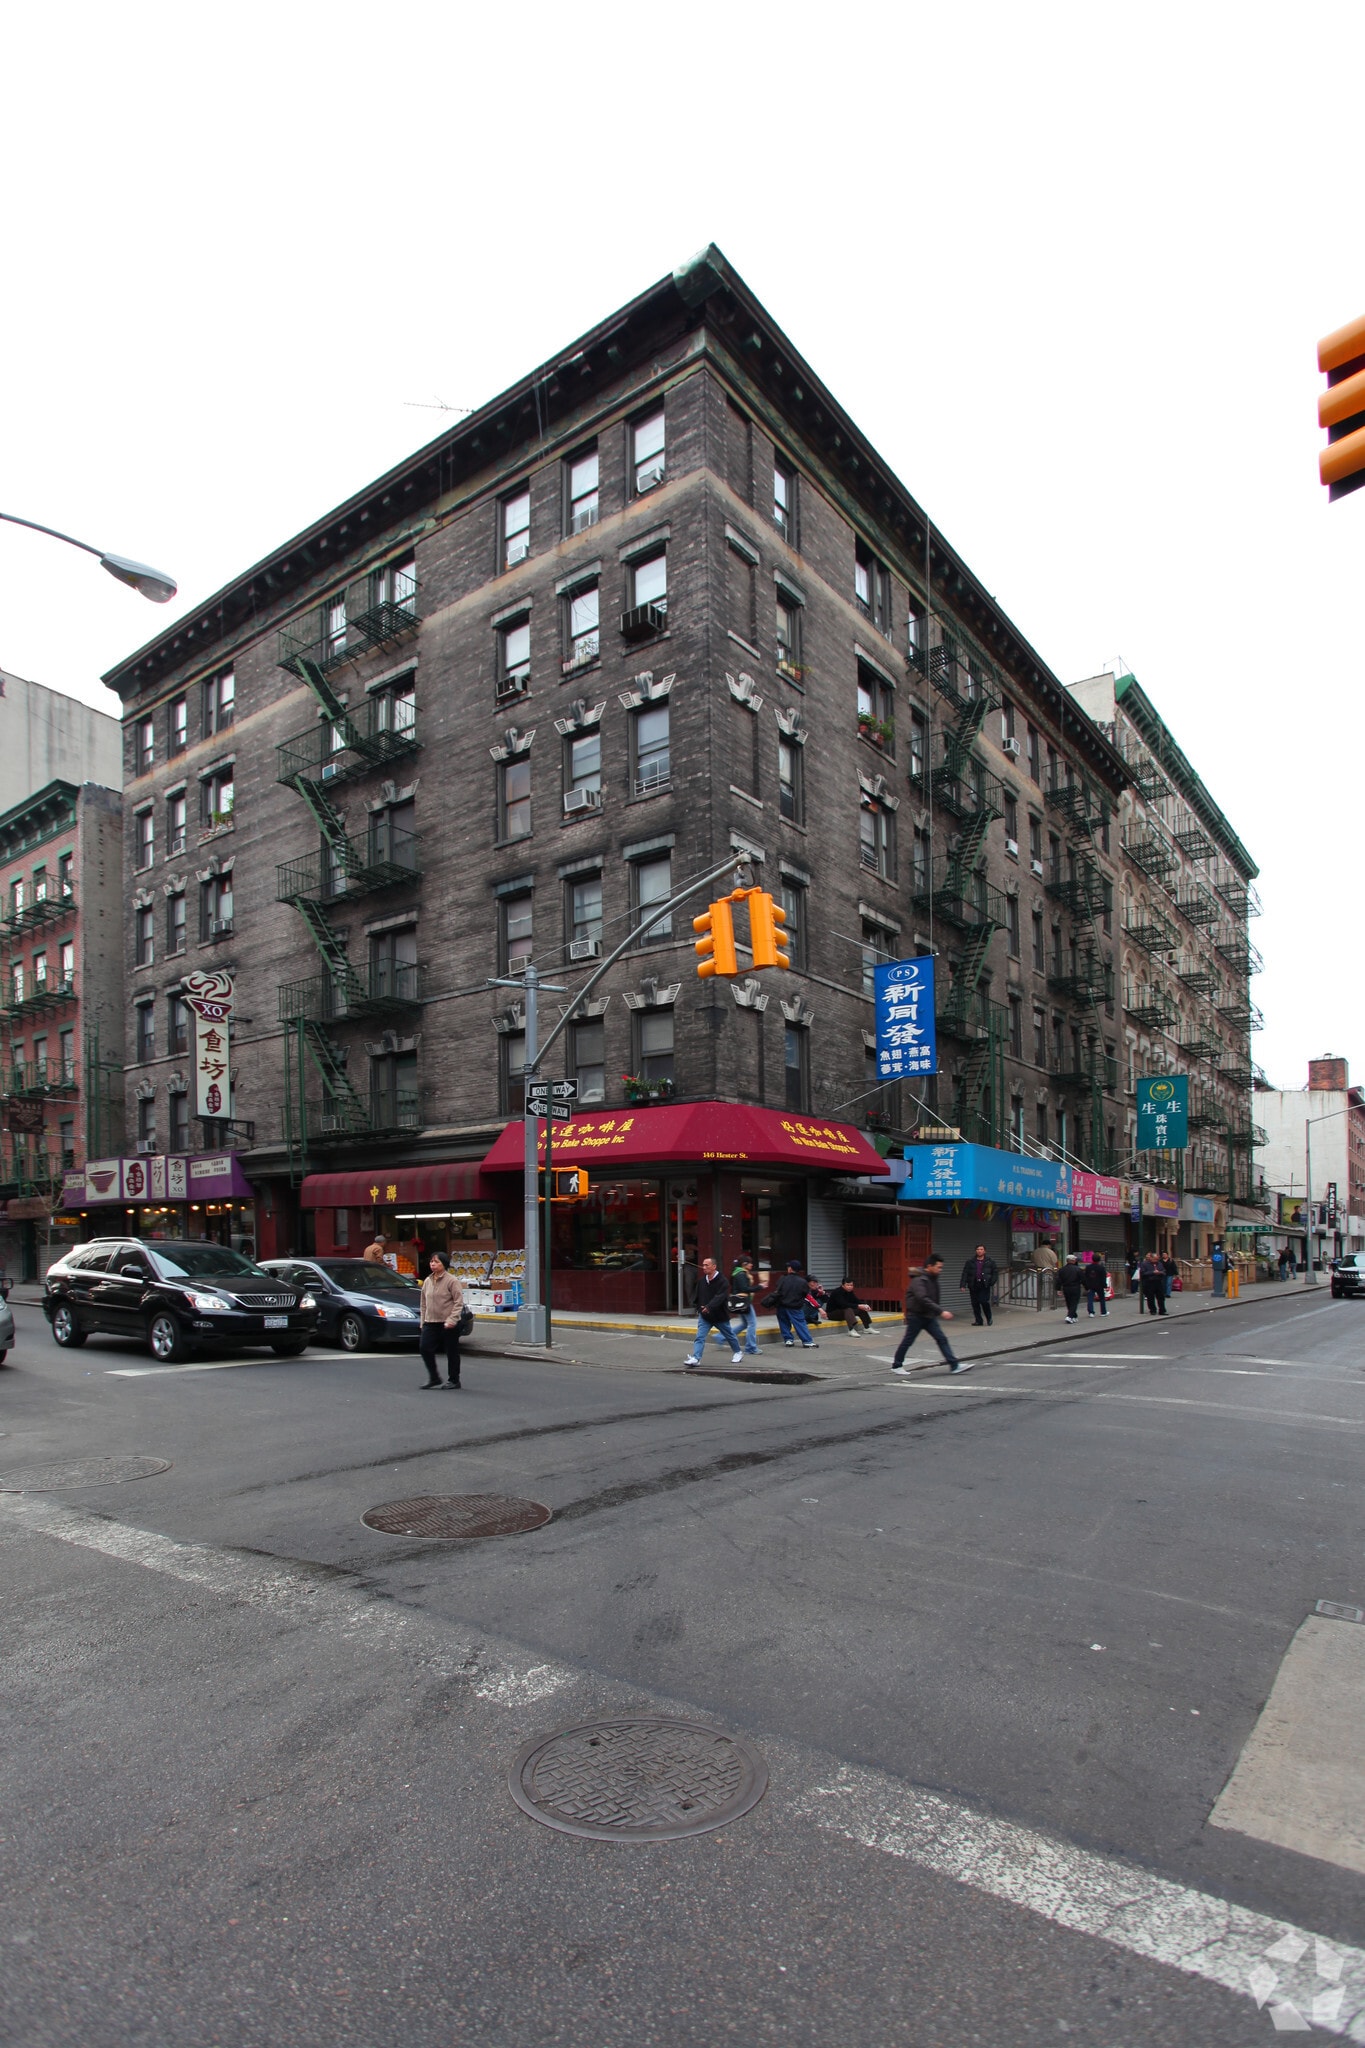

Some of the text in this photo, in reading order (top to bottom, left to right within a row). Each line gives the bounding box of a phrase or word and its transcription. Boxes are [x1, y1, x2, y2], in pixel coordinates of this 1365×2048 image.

[202, 1004, 223, 1017] XO
[881, 981, 926, 1047] 新同發
[199, 1028, 227, 1081] 食坊
[555, 1085, 570, 1093] WAY
[532, 1103, 565, 1115] ONE WAY
[560, 1138, 580, 1148] Bake
[581, 1136, 611, 1147] Shoppe
[611, 1134, 625, 1144] Inc.
[1095, 1180, 1118, 1196] Phoenix
